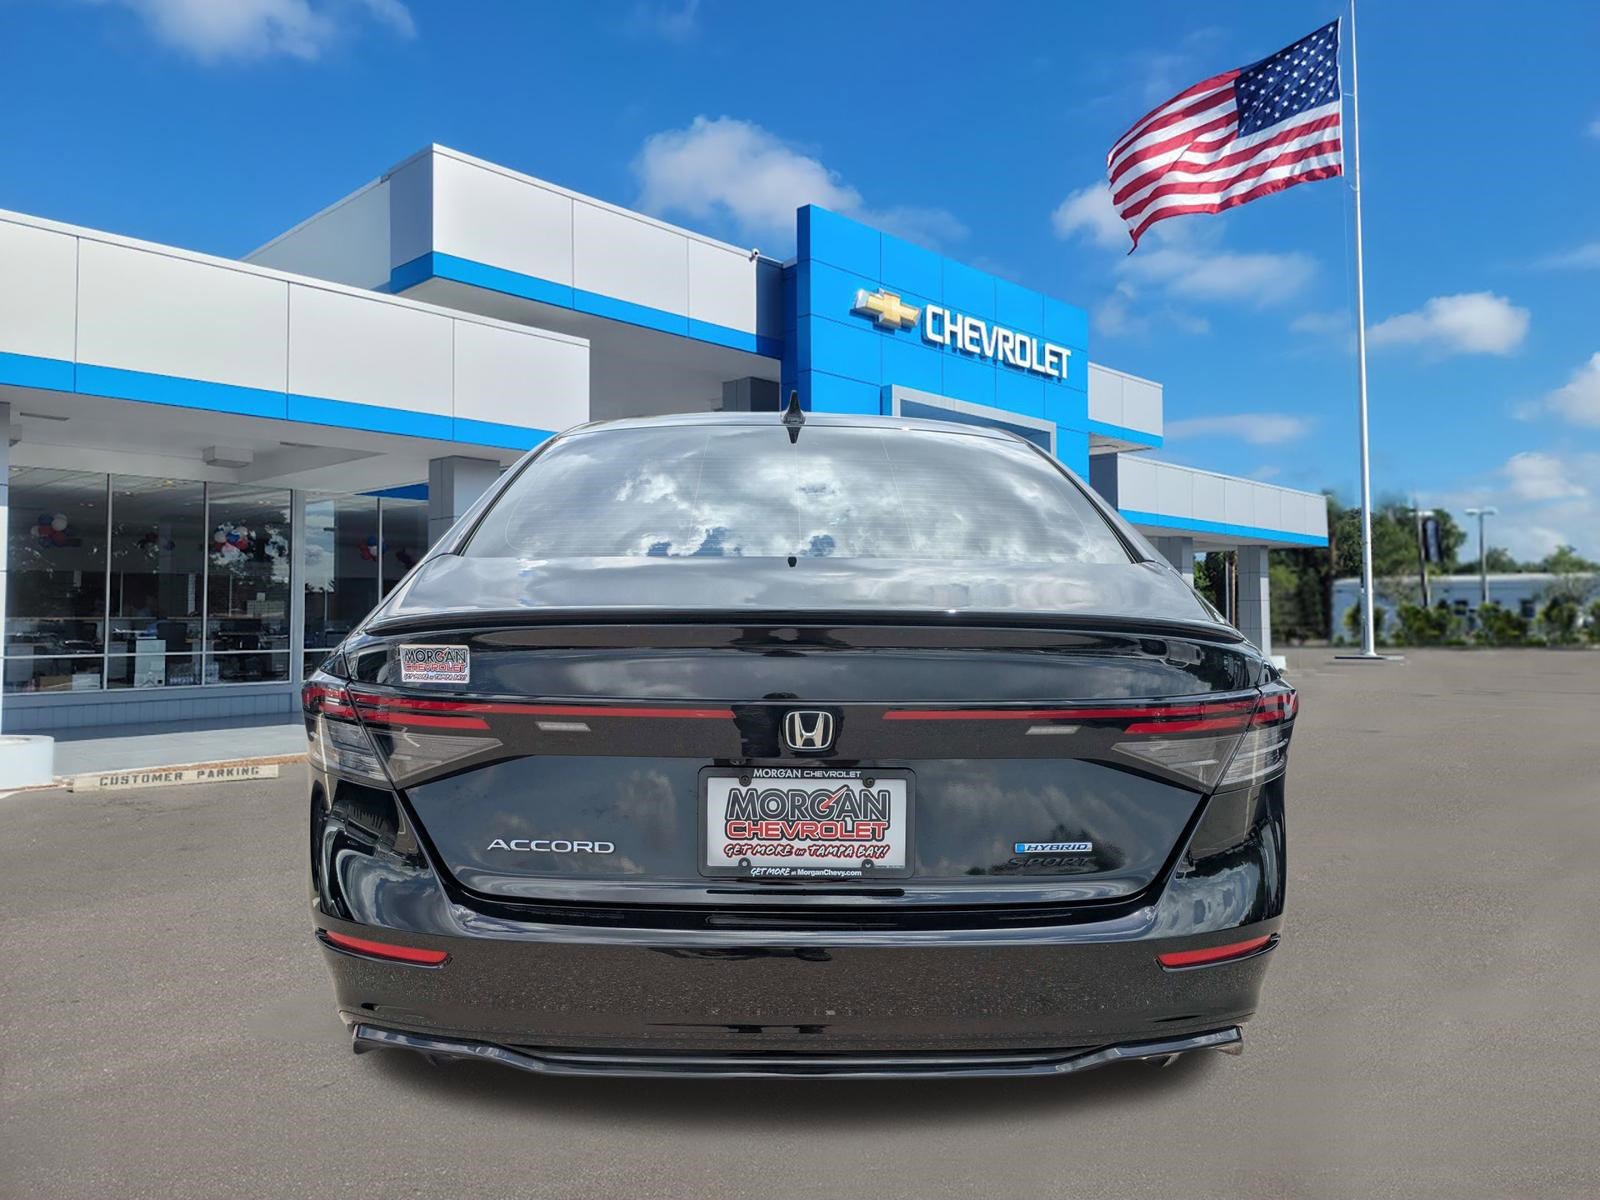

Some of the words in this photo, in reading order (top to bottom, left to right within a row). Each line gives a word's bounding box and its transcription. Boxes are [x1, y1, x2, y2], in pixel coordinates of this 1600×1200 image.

[924, 303, 1072, 380] CHEVROLET
[404, 647, 467, 663] MORGAN
[100, 771, 184, 787] CUSTOMER
[196, 765, 260, 780] PARKING
[753, 768, 801, 779] MORGAN
[803, 770, 862, 778] CHEVROLET
[726, 785, 890, 822] MORGAN
[726, 821, 889, 841] CHEVROLET
[487, 838, 615, 854] ACCORD
[724, 844, 751, 858] GET
[752, 844, 793, 857] MORE
[808, 844, 854, 858] TAMPA
[856, 845, 890, 859] BAY!
[1026, 843, 1089, 851] HYBRID
[1007, 856, 1096, 868] SPORT
[750, 867, 767, 876] GET
[767, 867, 791, 876] MORE
[797, 868, 863, 877] MorganChevy.com
